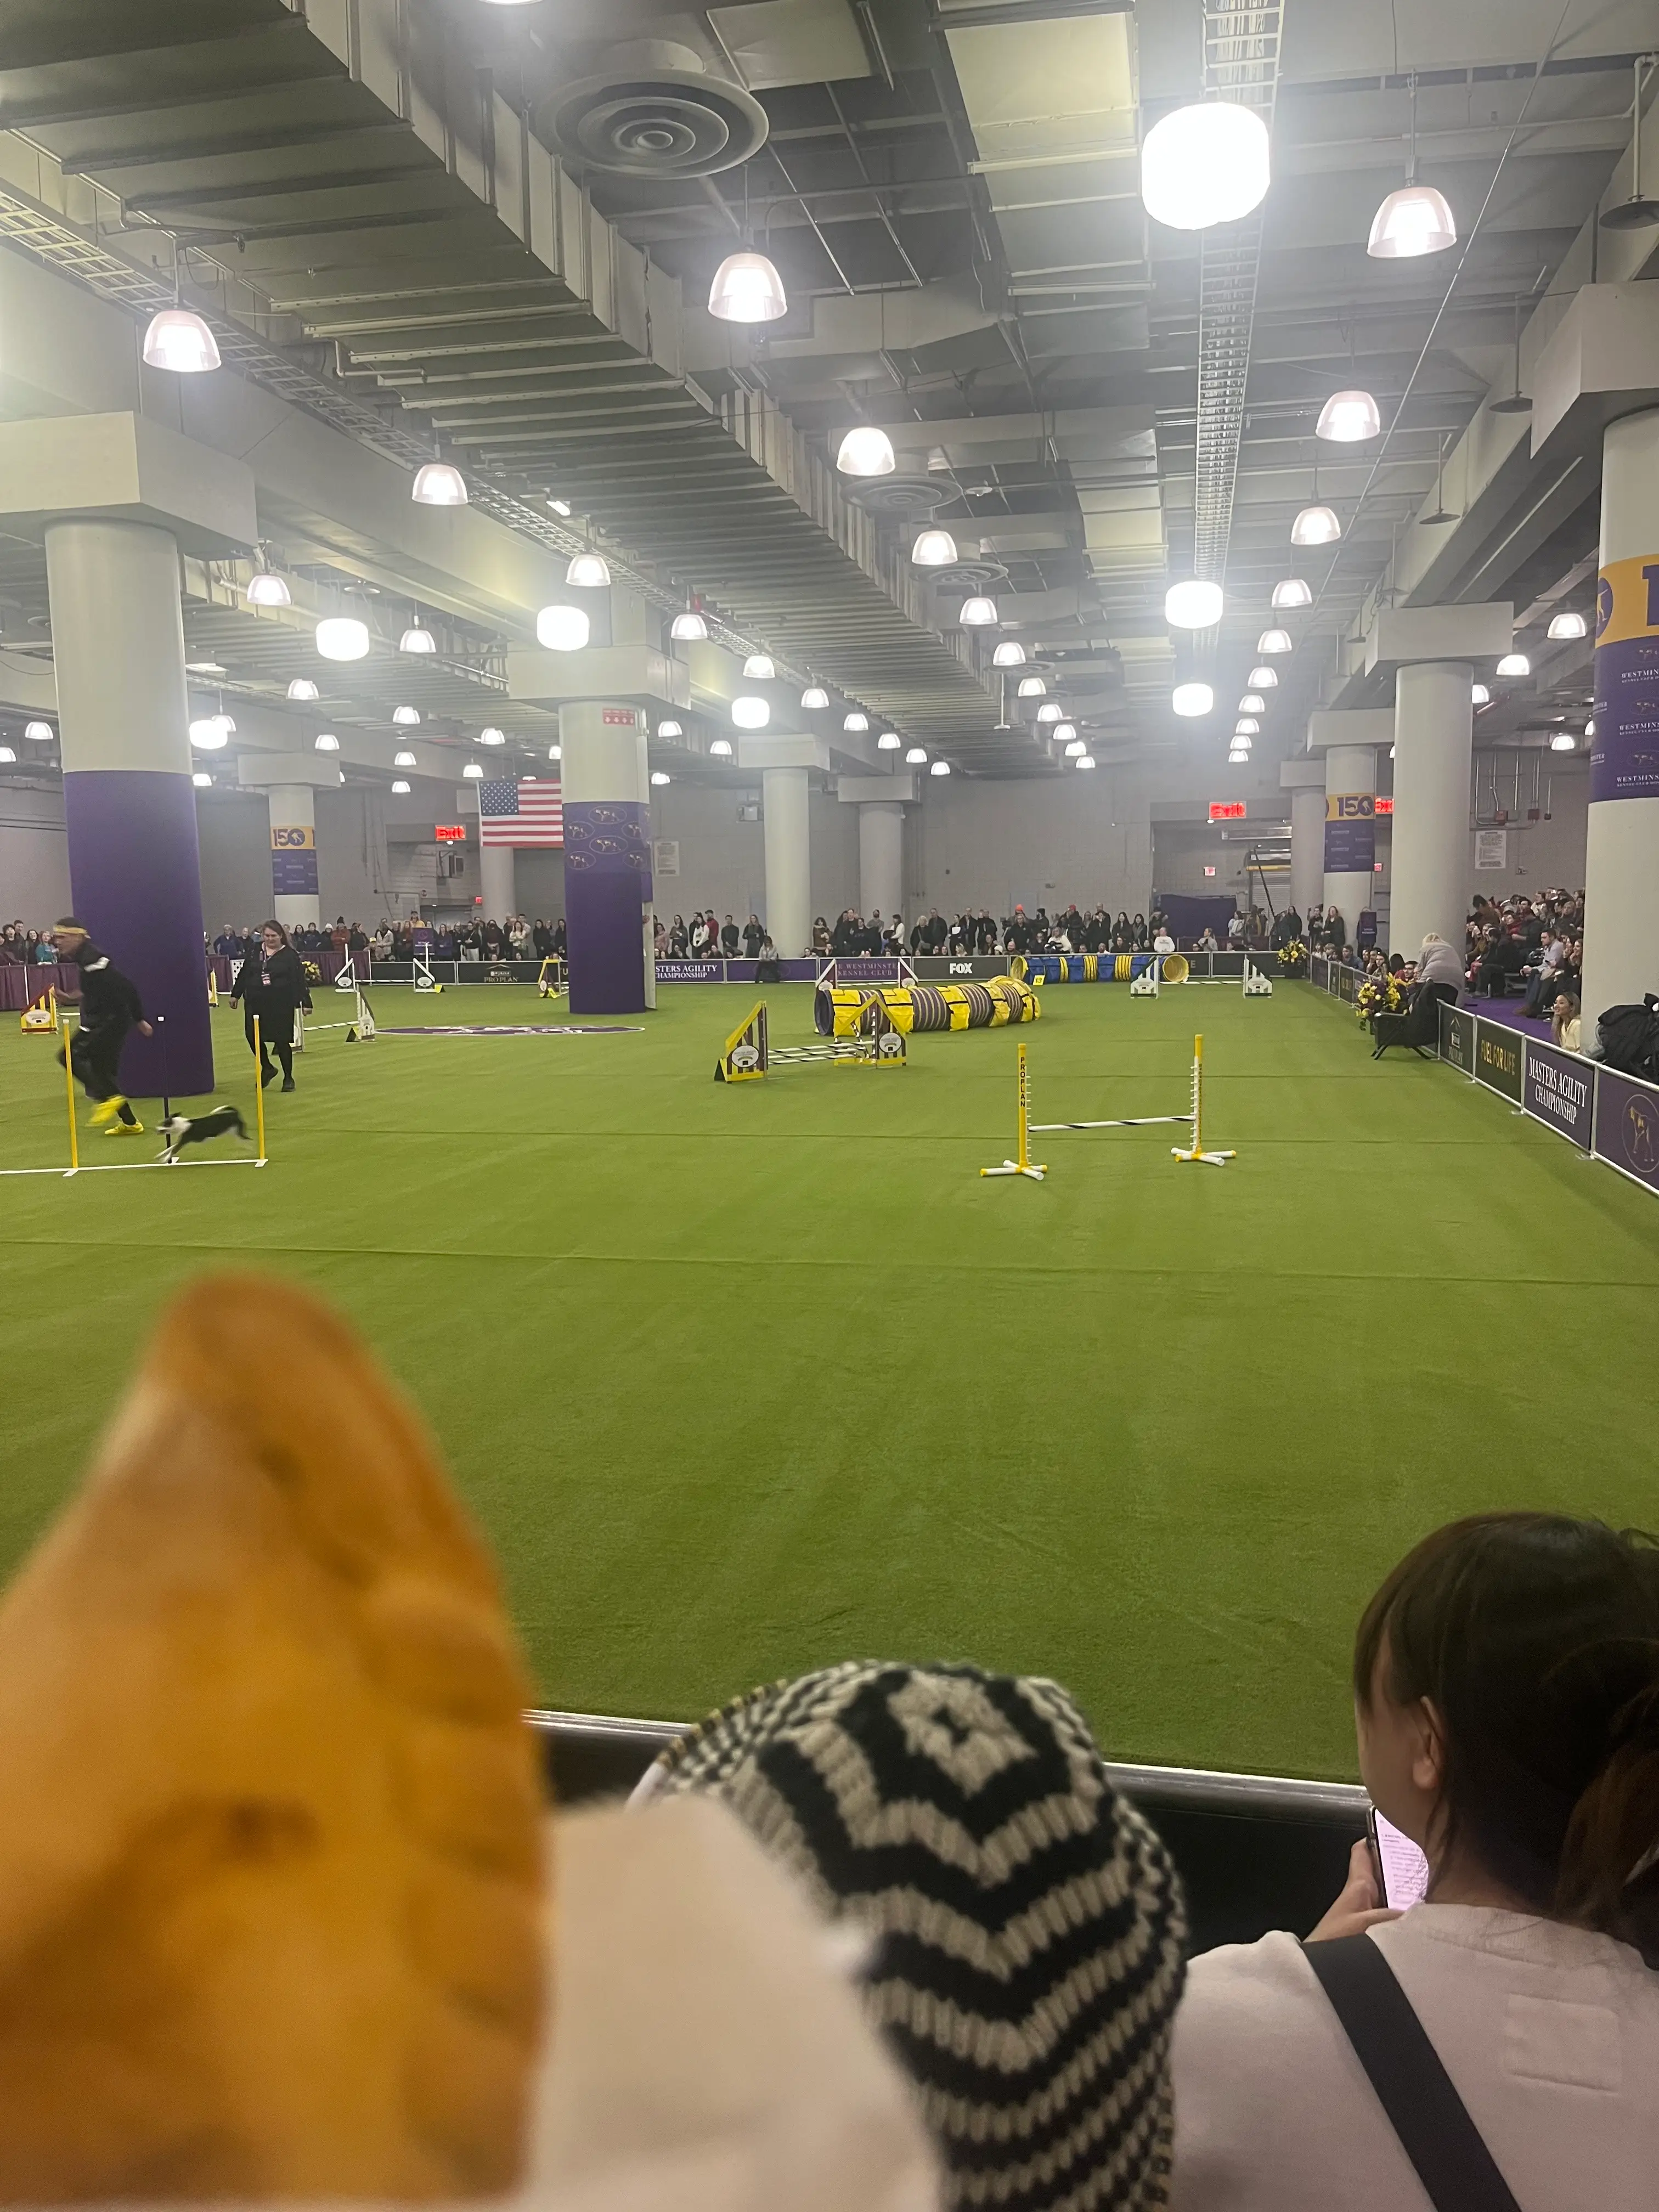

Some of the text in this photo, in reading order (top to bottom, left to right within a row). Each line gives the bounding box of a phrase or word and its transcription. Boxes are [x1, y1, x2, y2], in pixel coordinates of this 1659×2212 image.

[1210, 803, 1245, 819] Exit
[436, 826, 465, 839] Exit
[950, 963, 973, 974] FOX
[1493, 1045, 1503, 1070] FOR
[1528, 1057, 1587, 1108] MASTERS AGILITY
[1535, 1084, 1577, 1125] CHAMPIONSHIP
